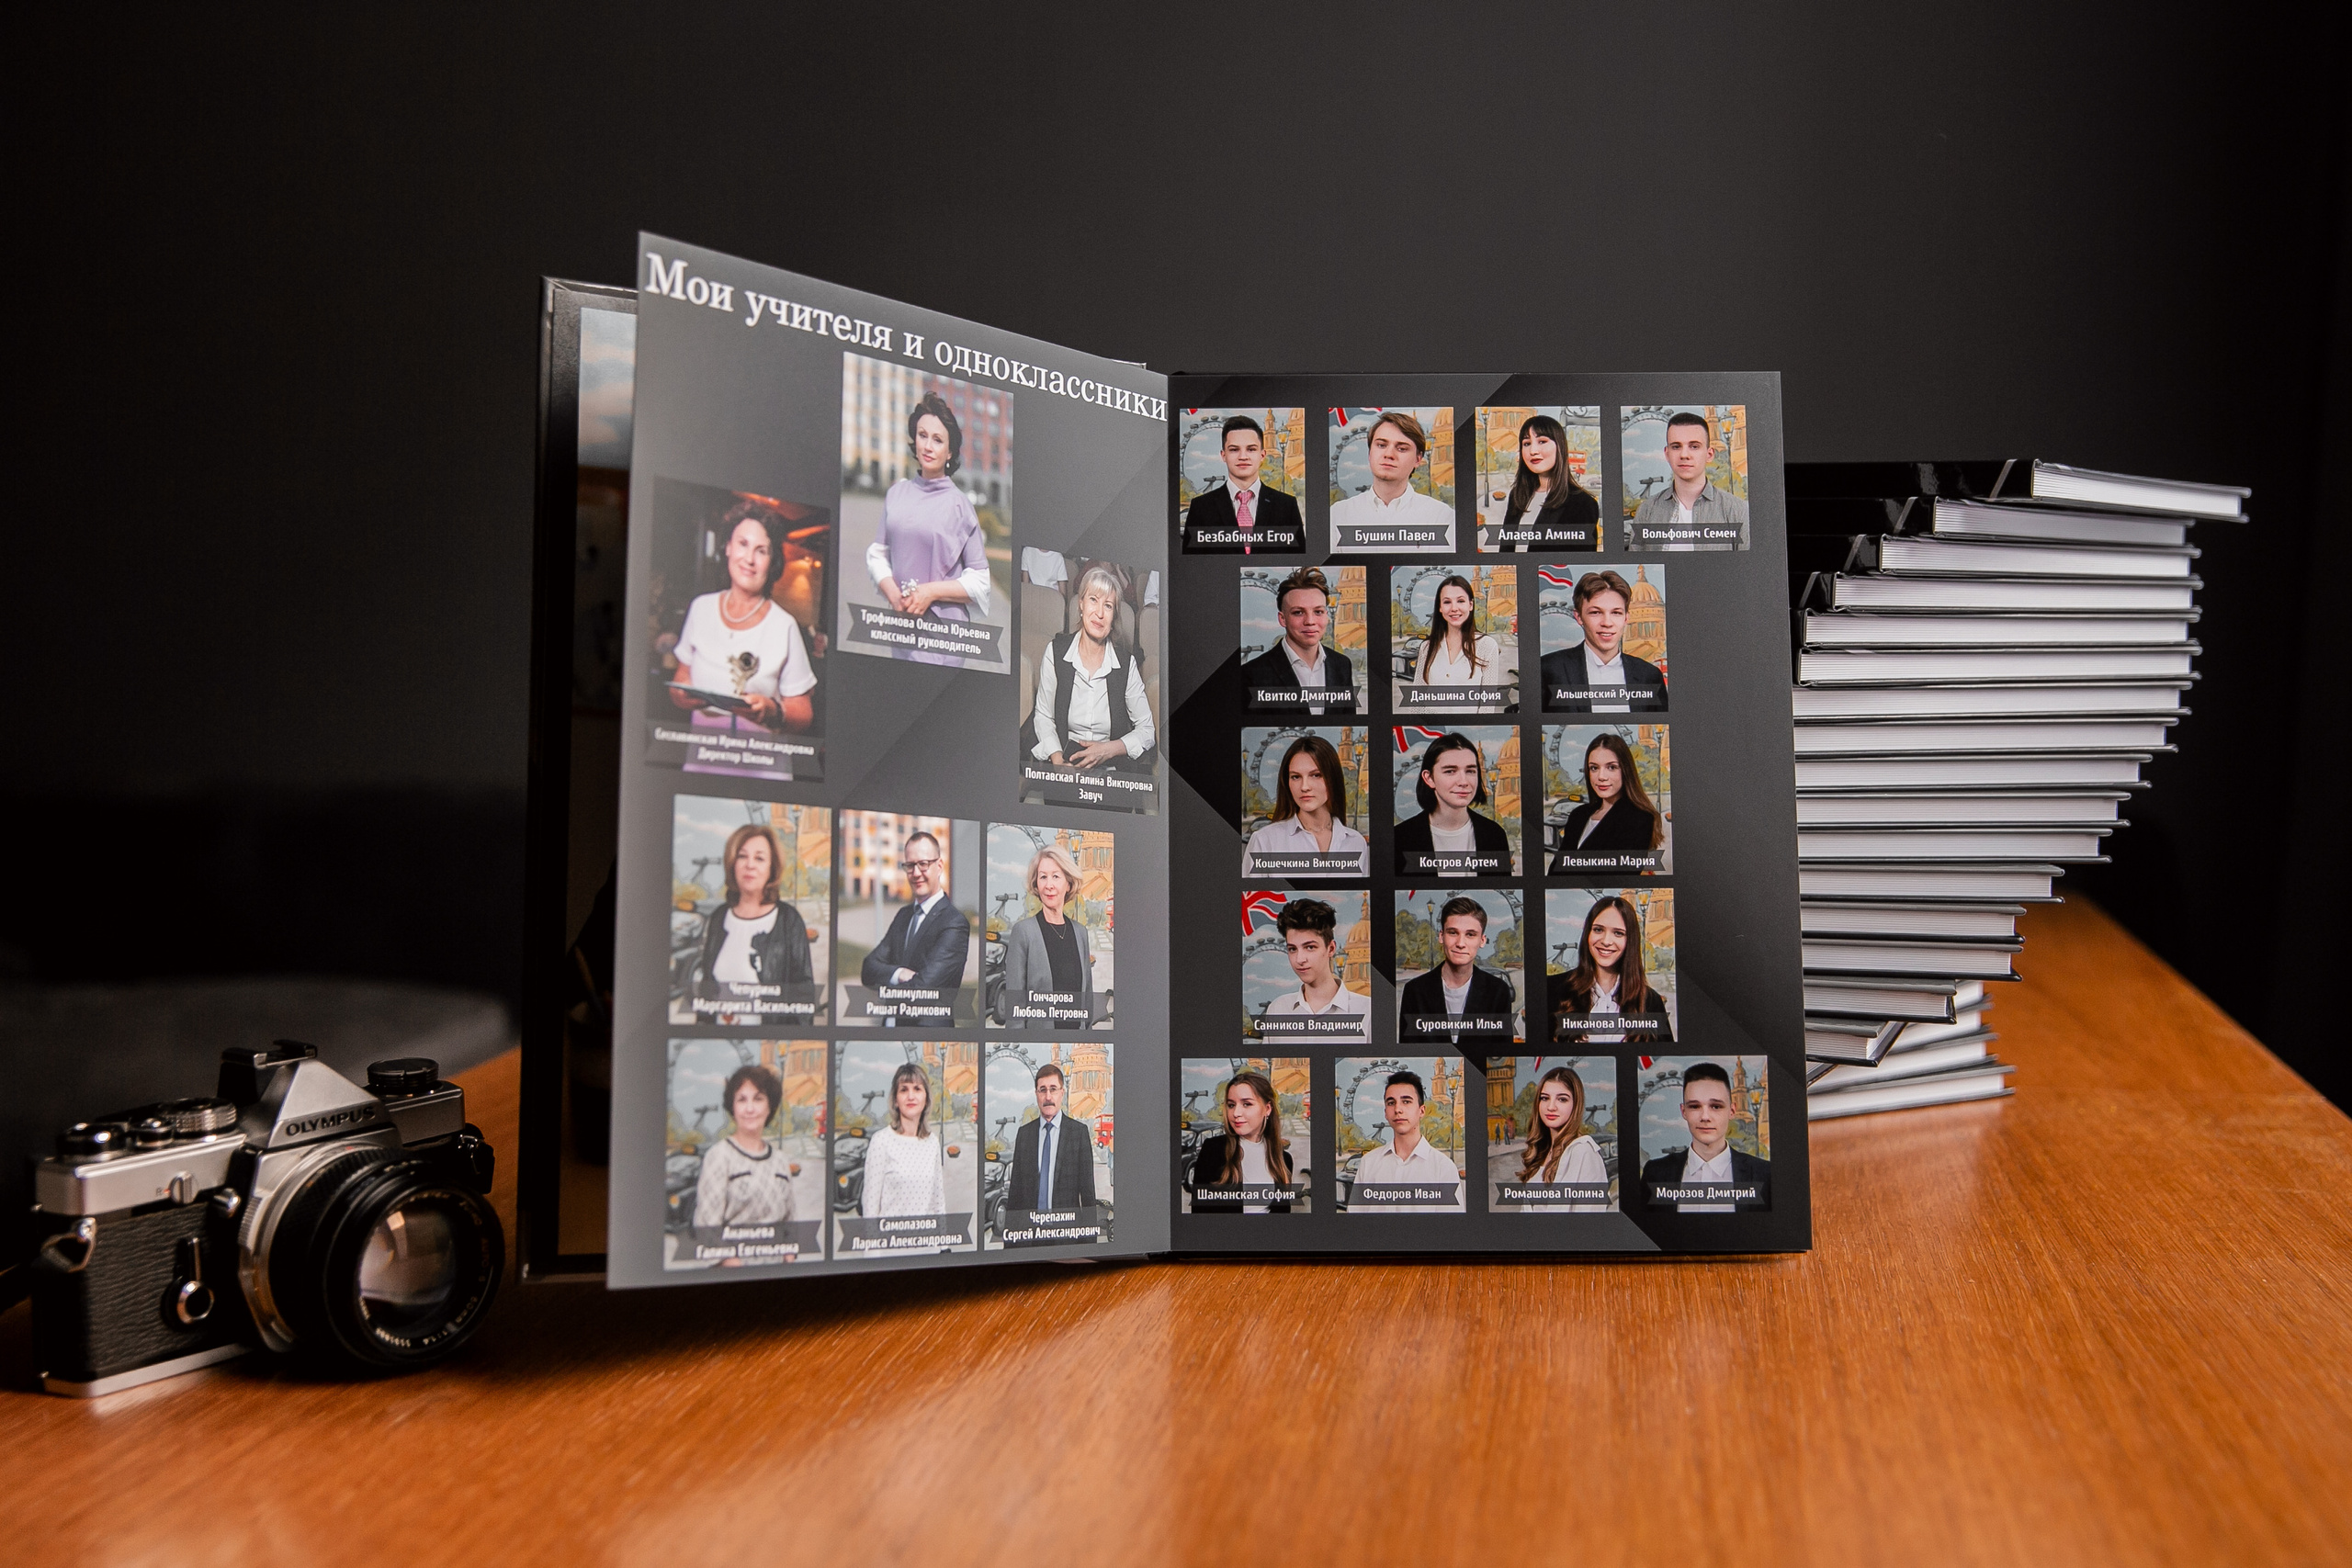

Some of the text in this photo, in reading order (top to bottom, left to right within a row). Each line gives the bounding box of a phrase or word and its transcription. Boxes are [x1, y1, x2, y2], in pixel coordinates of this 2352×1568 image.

[644, 252, 1168, 422] Мои учителя и одноклассники
[1197, 530, 1295, 545] Безбабных Егор
[1355, 530, 1435, 544] Бушин Павел
[1498, 529, 1586, 541] Алаева Амина
[1643, 527, 1736, 541] Вольфович Семен
[860, 608, 991, 641] Трофимова Оксана Юрьевна
[870, 628, 982, 655] классный руководитель
[1257, 689, 1351, 704] Квитко Дмитрий
[1410, 690, 1501, 703] Даньшина София
[1555, 688, 1654, 701] Альшевский Руслан
[1024, 766, 1154, 793] Полтавская Галина Викторовна
[1078, 787, 1103, 804] Завуч
[1255, 857, 1359, 870] Кошечкина Виктория
[1419, 856, 1498, 870] Костров Артем
[1563, 855, 1656, 868] Левыкина Мария
[879, 986, 940, 1002] Калимуллин
[1028, 989, 1074, 1005] Гончарова
[866, 1001, 952, 1018] Ришат Радикович
[1012, 1005, 1089, 1021] Любовь Петровна
[1253, 1019, 1363, 1032] Санников Владимир
[1416, 1018, 1503, 1032] Суровикин Илья
[1563, 1017, 1658, 1029] Никанова Полина
[286, 1106, 376, 1136] OLYMPUS
[1197, 1188, 1296, 1202] Шаманская София
[1363, 1187, 1442, 1201] Федоров Иван
[1504, 1187, 1605, 1201] Ромашова Полина
[1656, 1186, 1756, 1201] Морозов Дмитрий
[878, 1218, 938, 1232] Самолазова
[1029, 1211, 1076, 1225] Черепахин
[1002, 1225, 1101, 1243] Сергей Александрович
[852, 1233, 963, 1251] Лариса Александровна
